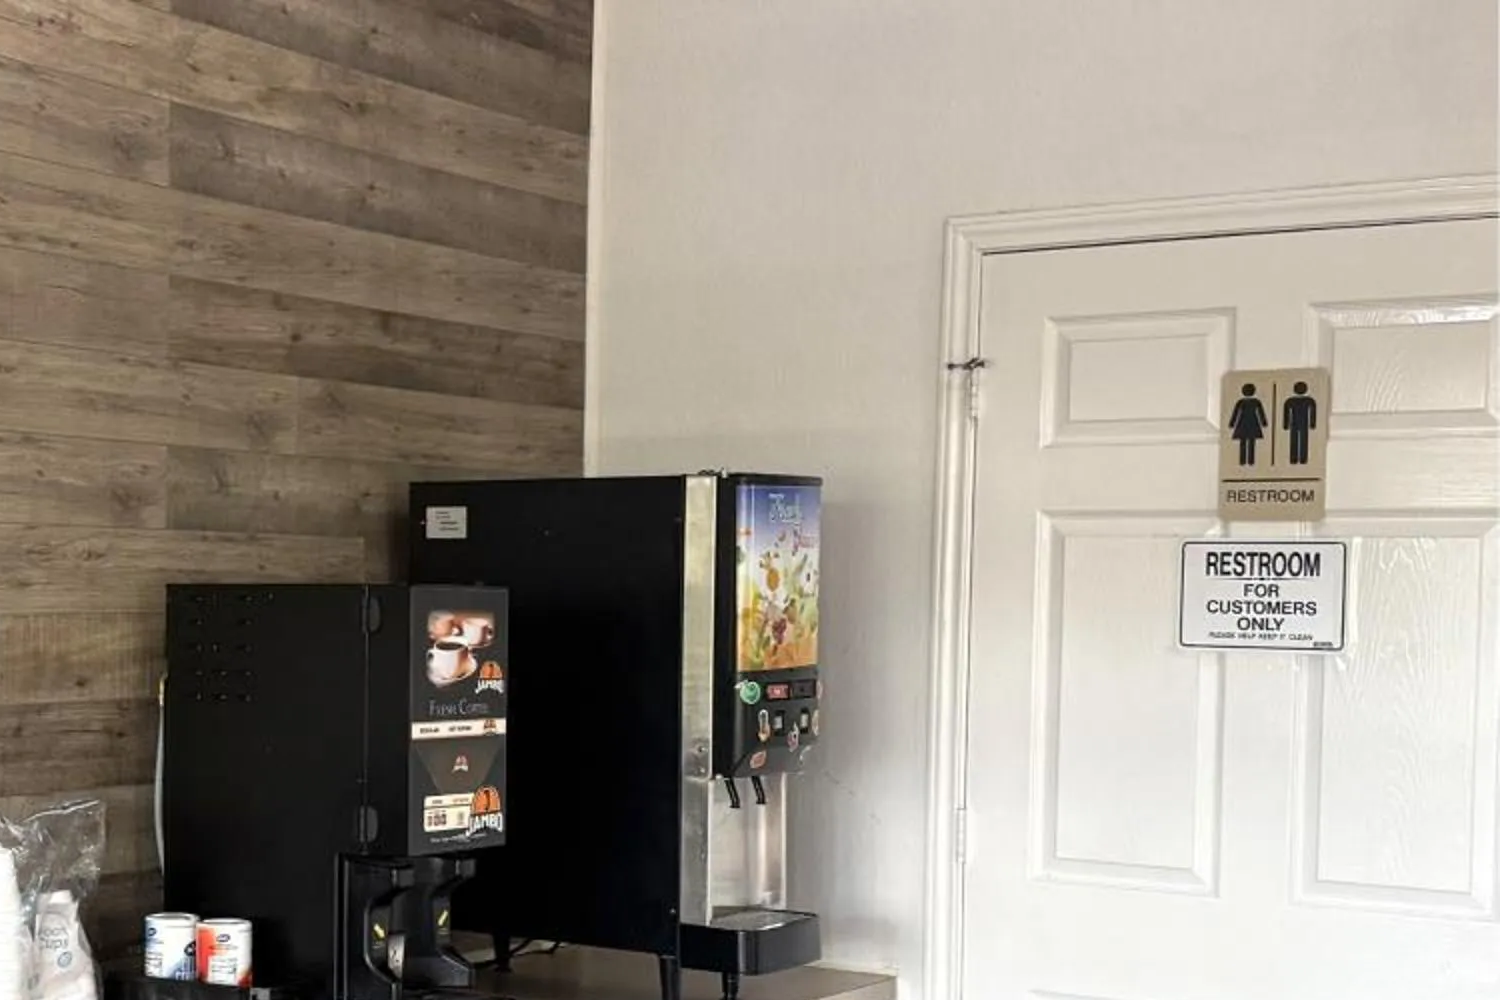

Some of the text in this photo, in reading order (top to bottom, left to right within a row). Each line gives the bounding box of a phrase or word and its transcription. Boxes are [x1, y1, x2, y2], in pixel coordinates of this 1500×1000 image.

[1226, 488, 1315, 504] RESTROOM
[1206, 551, 1321, 577] RESTROOM
[1243, 583, 1279, 599] FOR
[1206, 600, 1317, 616] CUSTOMERS
[1236, 616, 1285, 631] ONLY
